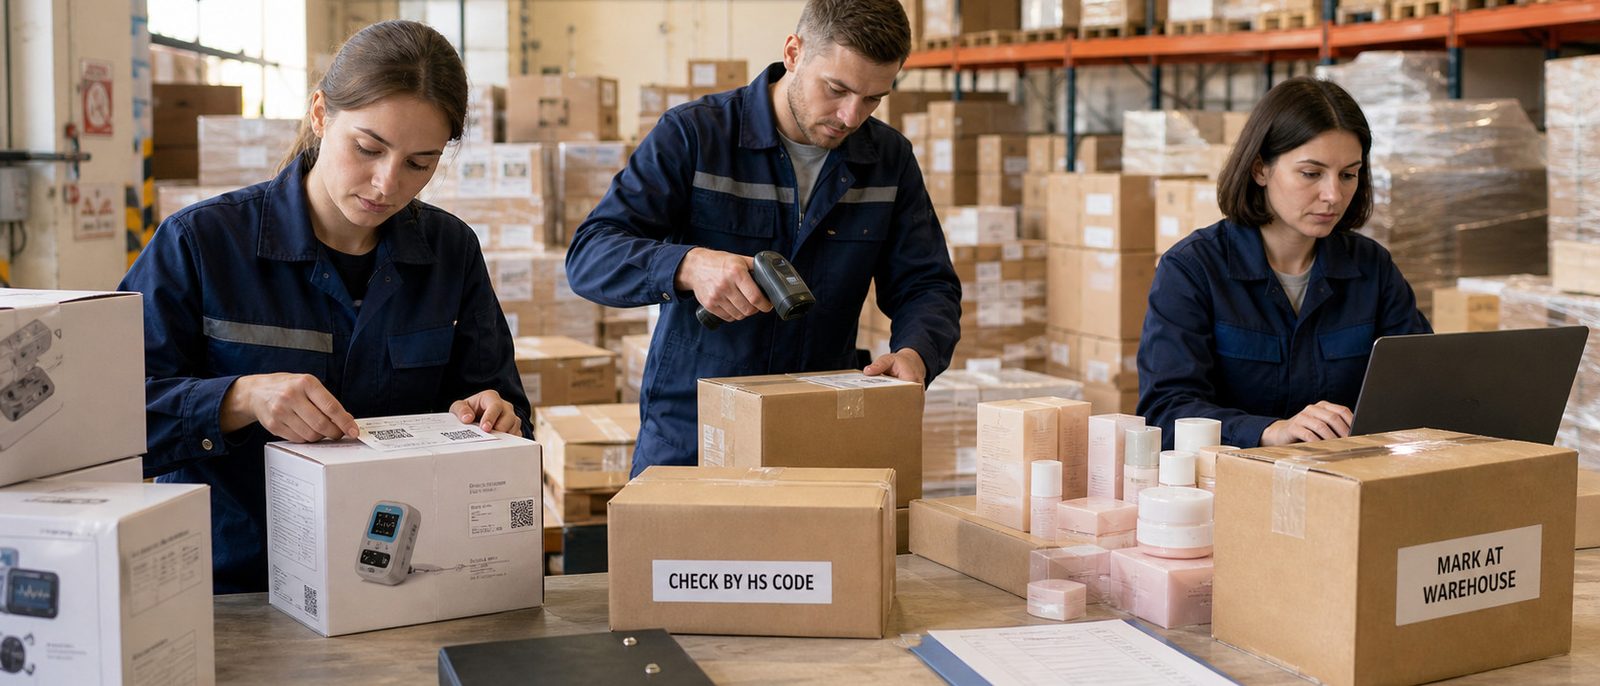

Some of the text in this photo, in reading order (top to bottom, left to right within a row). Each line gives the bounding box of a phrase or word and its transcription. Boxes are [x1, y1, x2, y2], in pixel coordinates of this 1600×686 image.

[1438, 546, 1504, 575] MARK AT
[669, 573, 814, 590] CHECK BY HS CODE
[1423, 570, 1516, 604] WAREHOUSE
